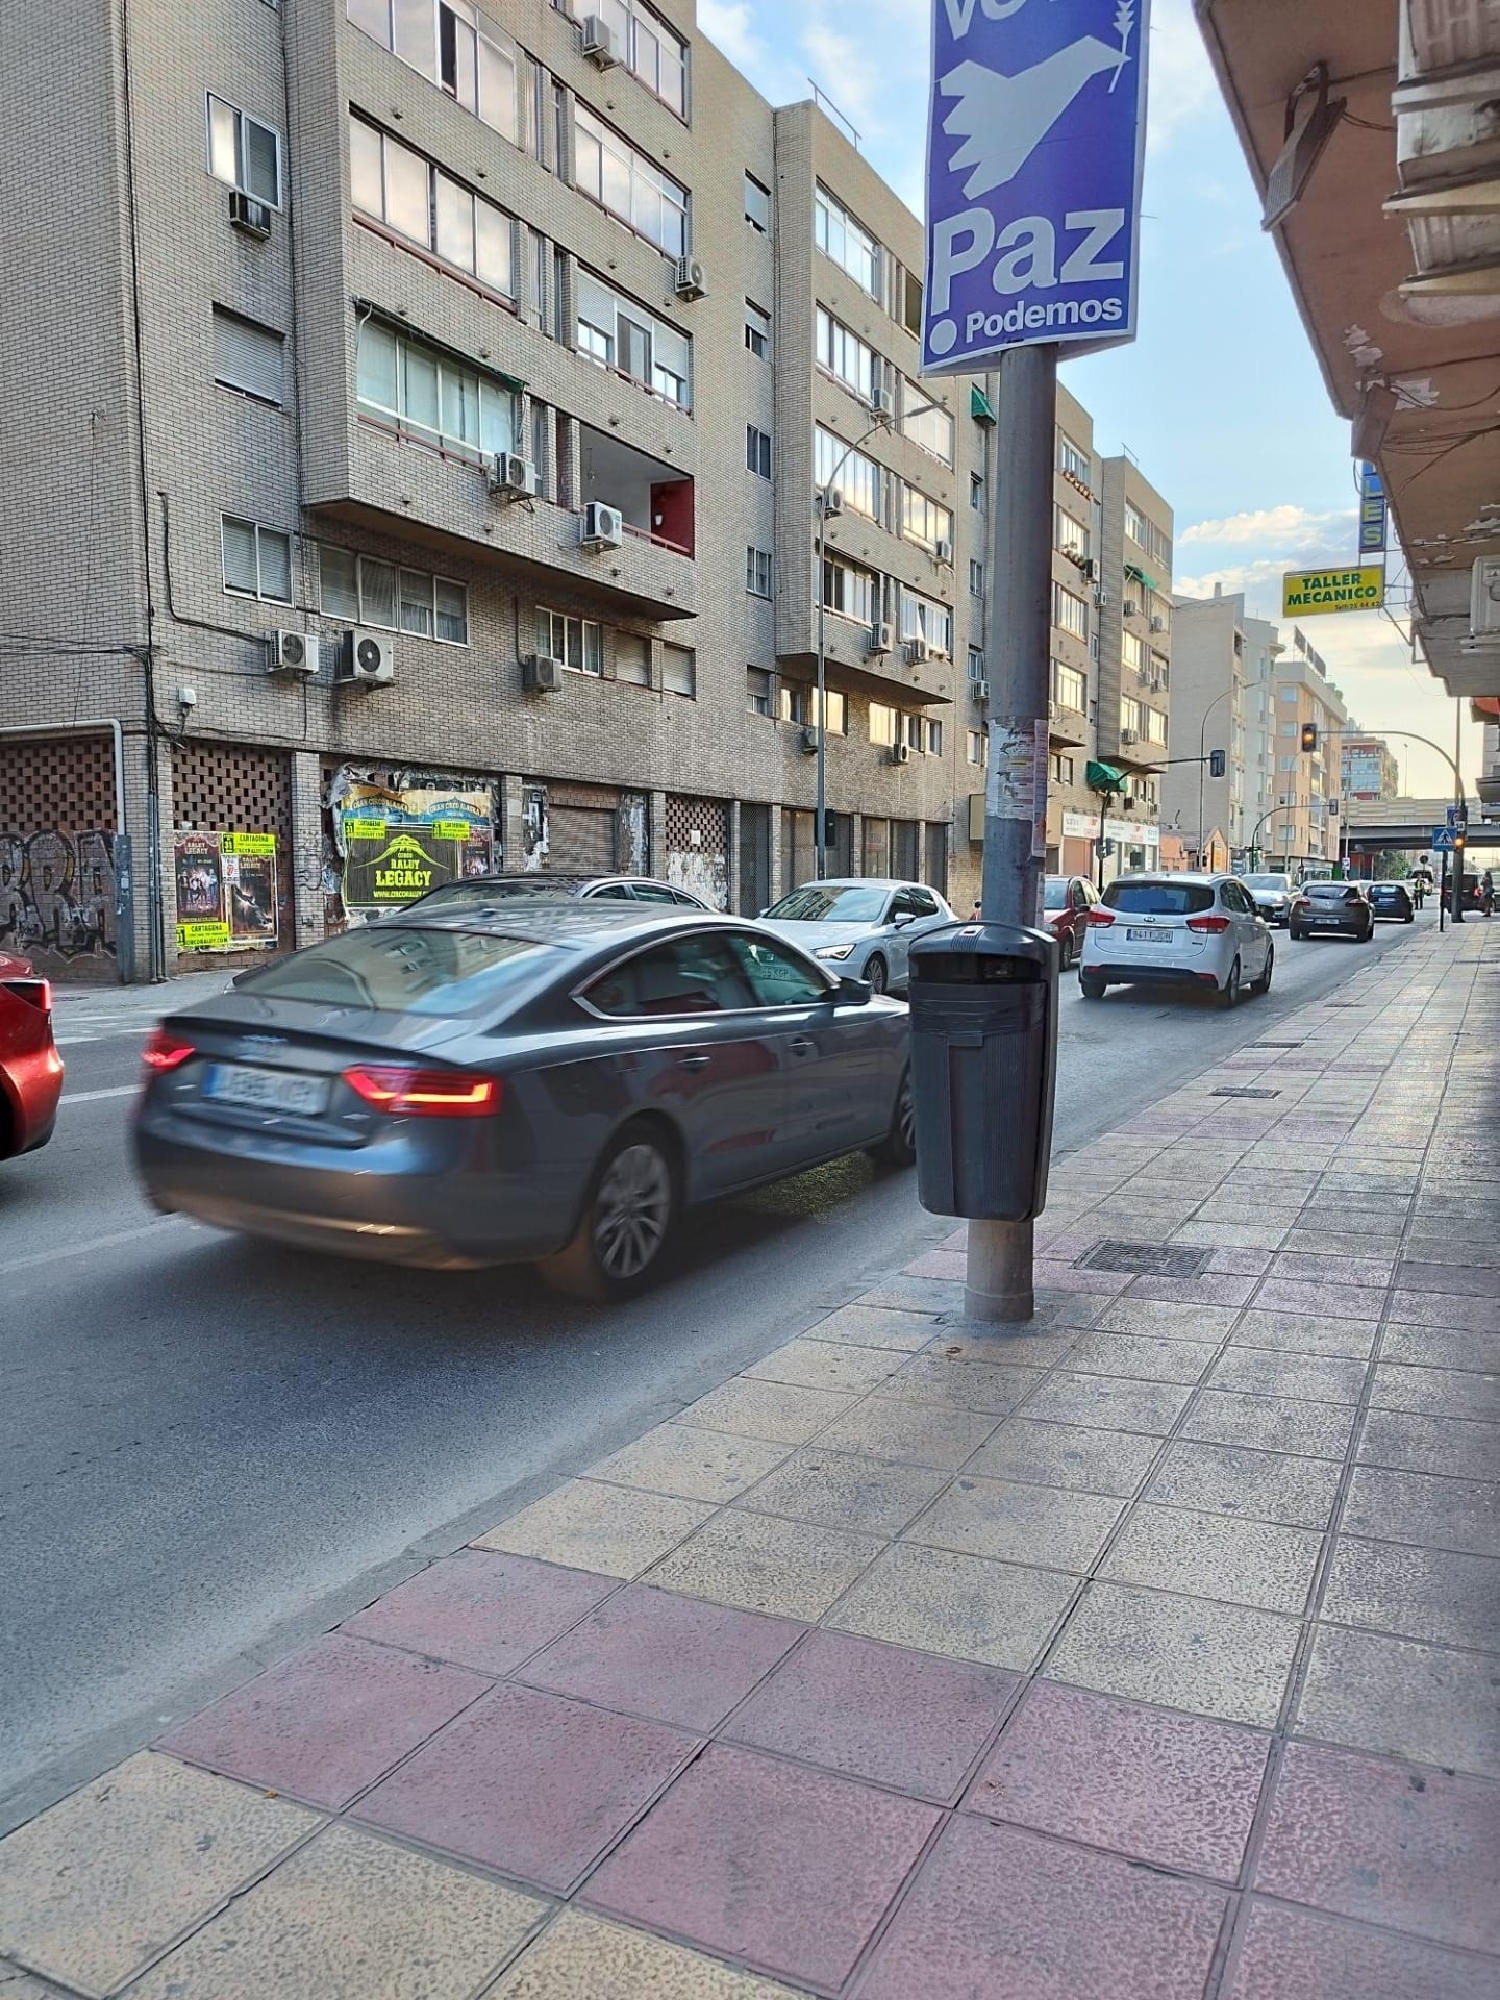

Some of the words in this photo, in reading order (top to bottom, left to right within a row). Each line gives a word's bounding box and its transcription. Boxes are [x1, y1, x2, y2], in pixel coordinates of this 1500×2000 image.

[931, 207, 1125, 316] Paz
[966, 297, 1123, 343] Podemos
[1302, 572, 1361, 590] TALLER
[1287, 585, 1377, 606] MECANICO
[239, 834, 269, 843] CARTAGENA
[390, 859, 420, 869] RALUY
[375, 870, 432, 887] LEGACY
[190, 924, 223, 932] CARTAGENA
